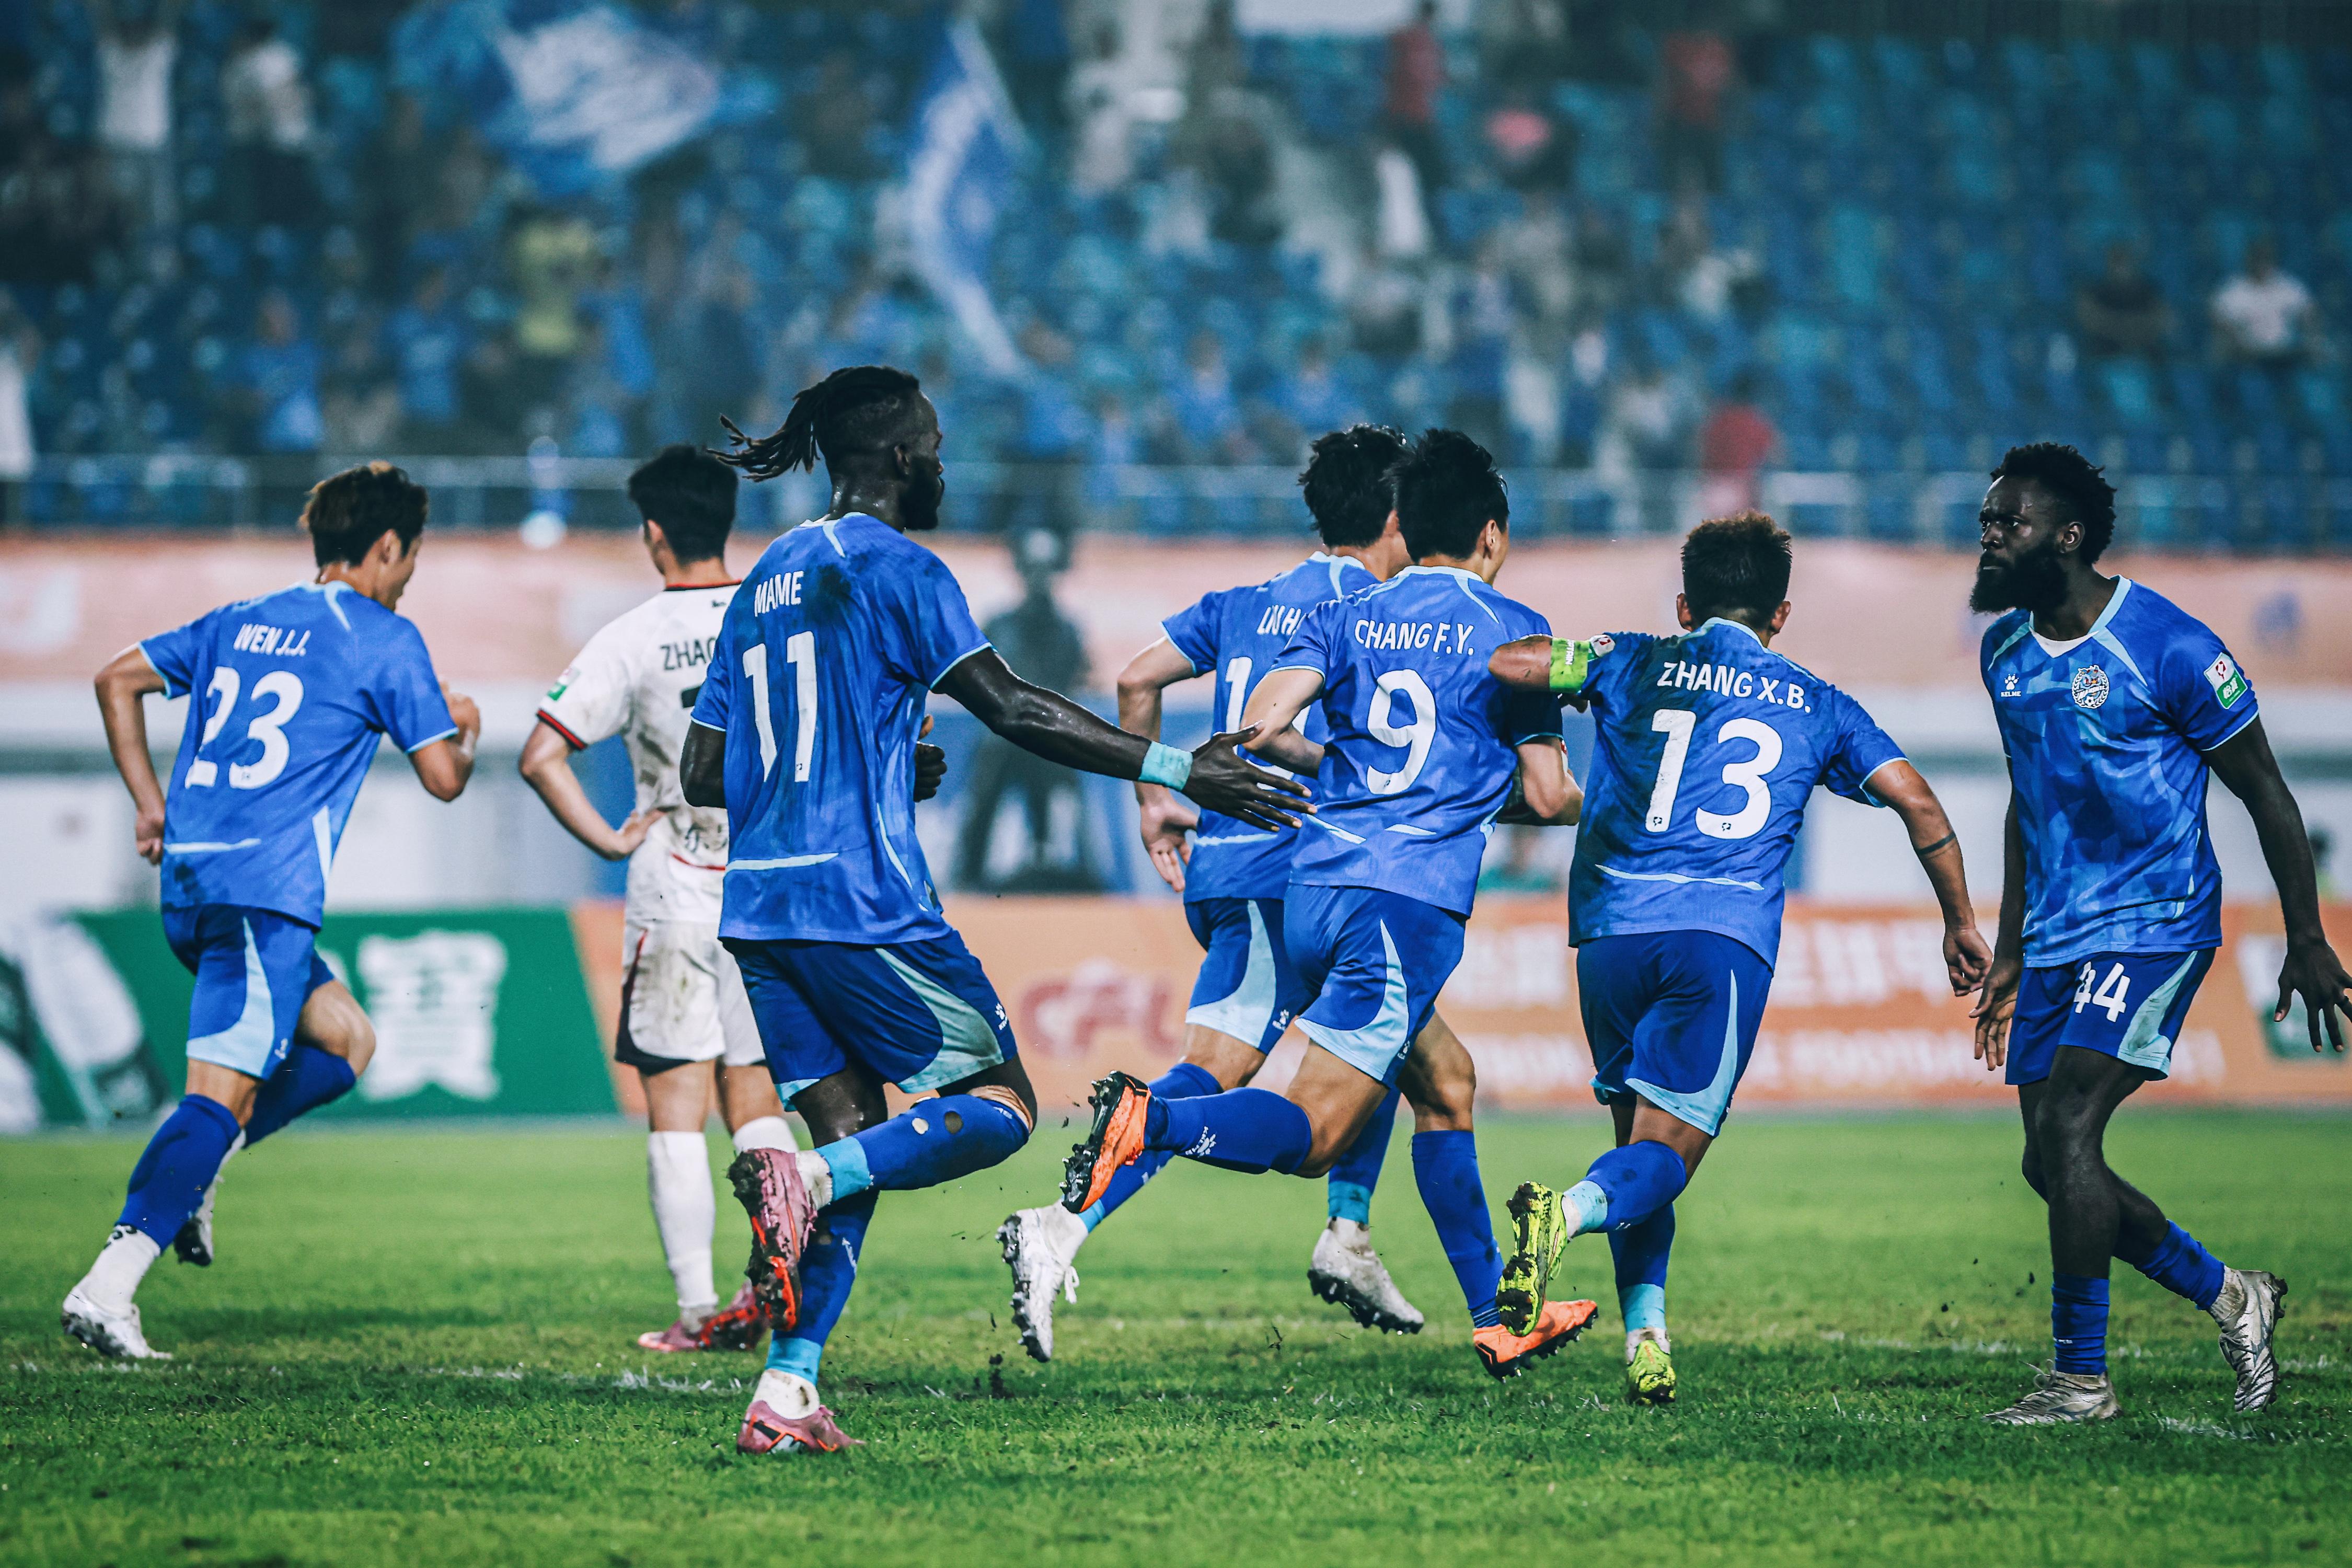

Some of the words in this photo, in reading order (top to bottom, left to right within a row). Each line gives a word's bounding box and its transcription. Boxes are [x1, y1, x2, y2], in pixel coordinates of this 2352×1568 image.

[754, 570, 804, 617] MAME
[233, 623, 283, 655] WEN
[1354, 619, 1433, 650] CHANG
[1433, 622, 1474, 656] F.Y.
[742, 630, 817, 782] 11
[1657, 660, 1753, 697] ZHANG
[1757, 676, 1811, 713] X.B.
[185, 666, 305, 790] 23
[1367, 668, 1437, 795] 9
[1645, 708, 1783, 839] 13
[2073, 961, 2130, 1022] 44
